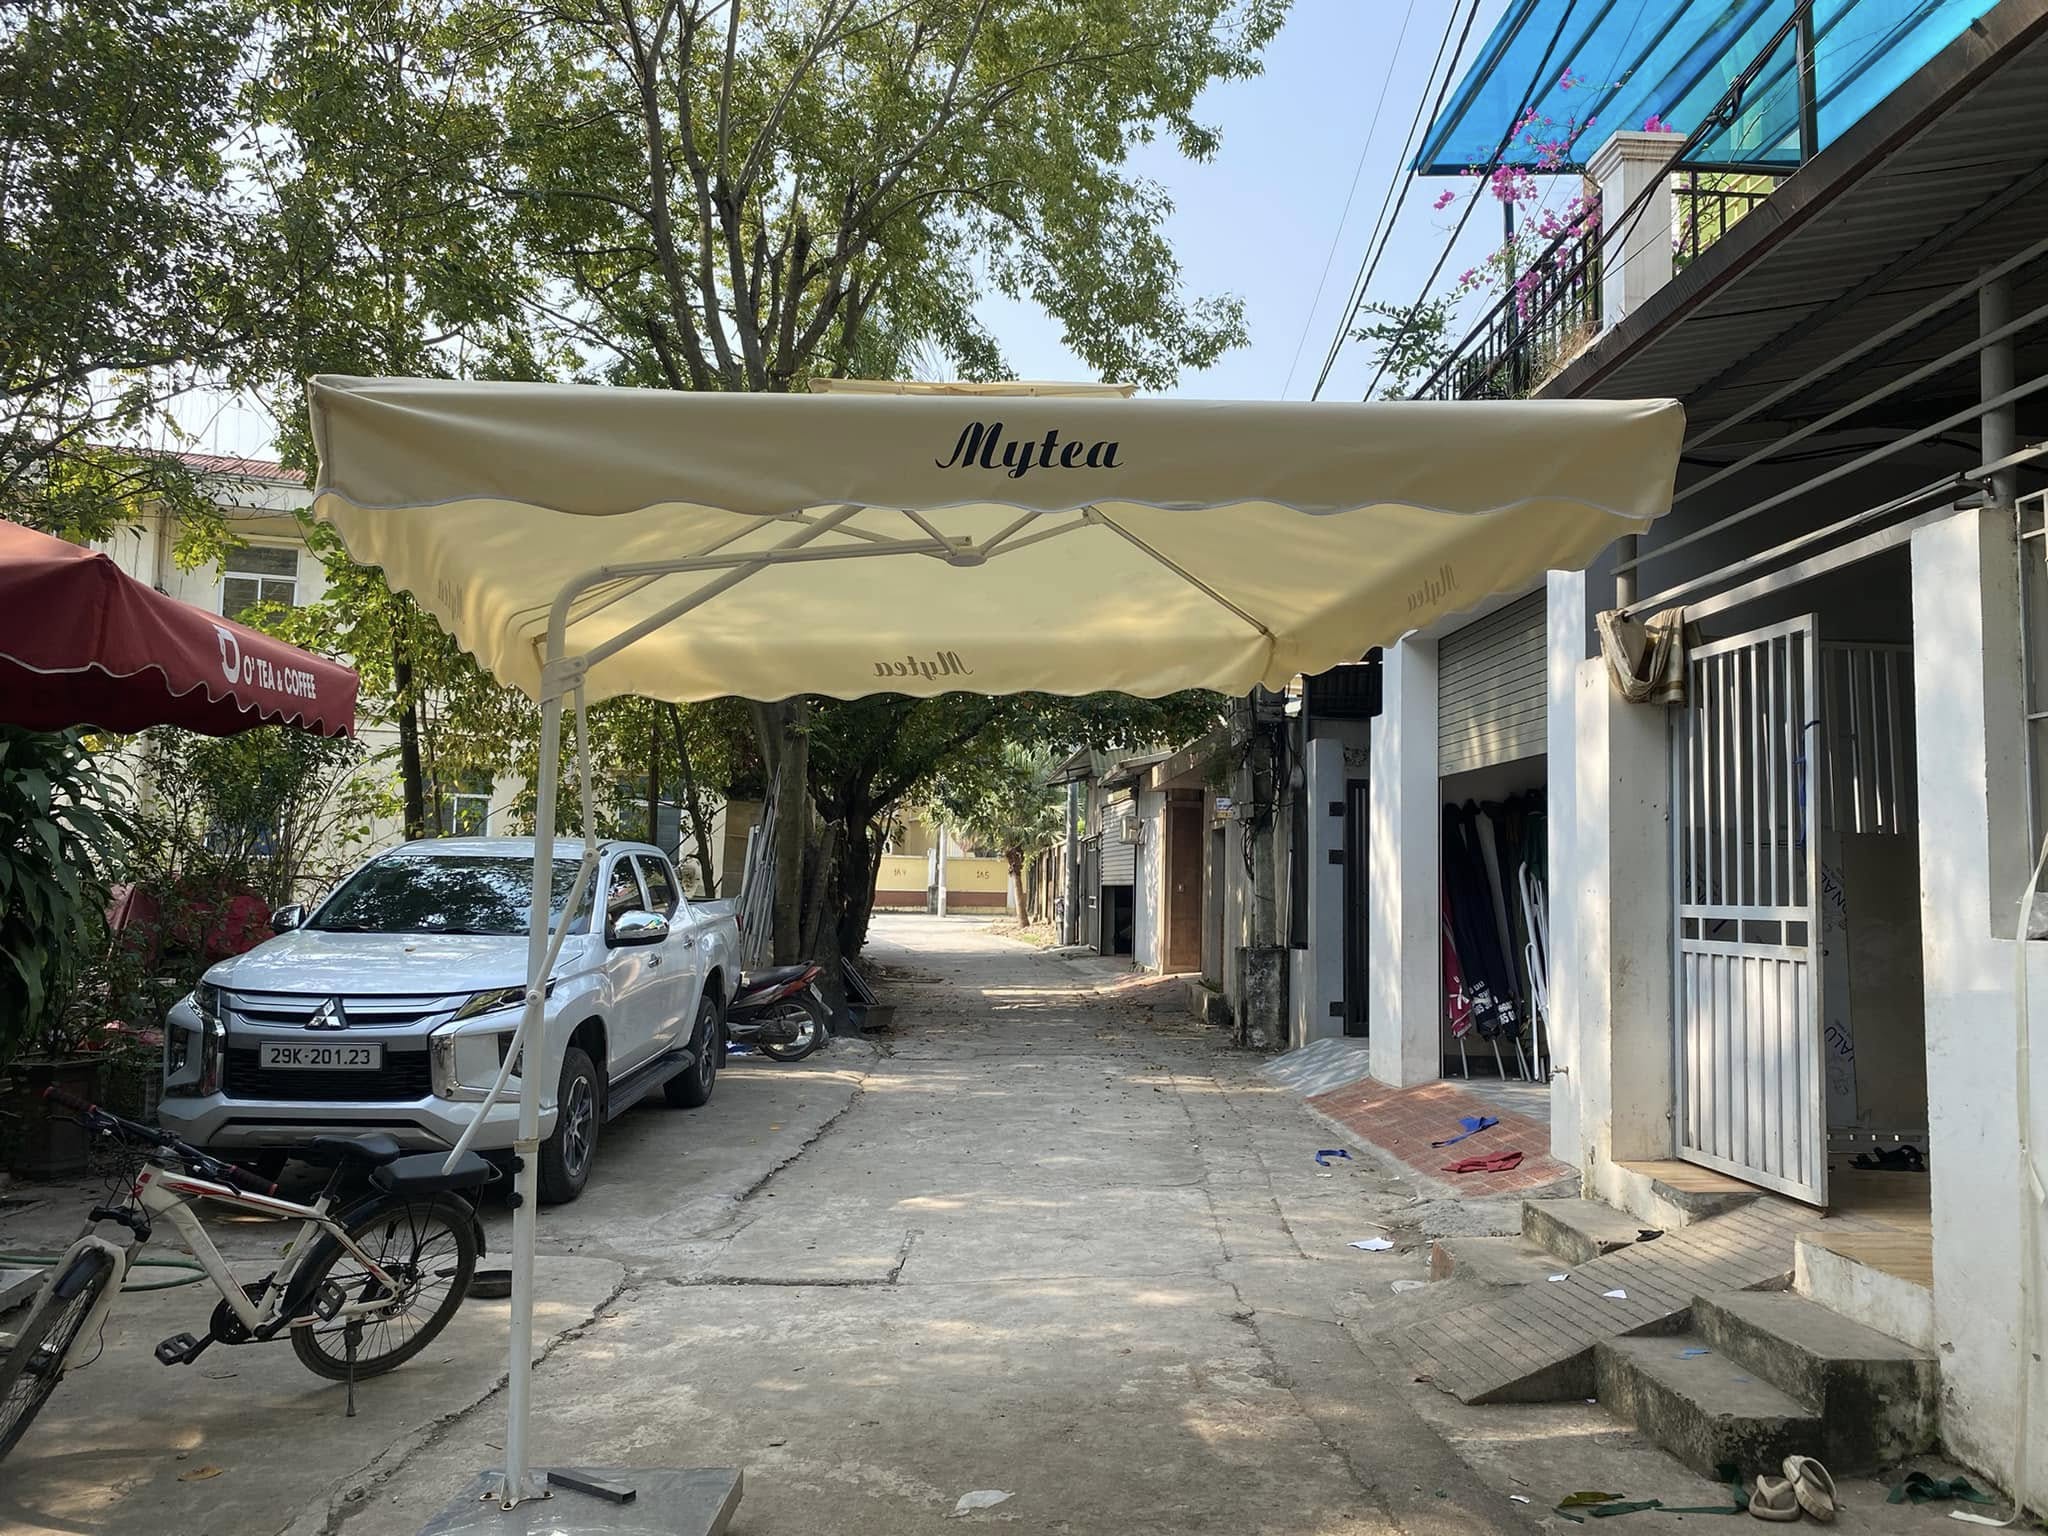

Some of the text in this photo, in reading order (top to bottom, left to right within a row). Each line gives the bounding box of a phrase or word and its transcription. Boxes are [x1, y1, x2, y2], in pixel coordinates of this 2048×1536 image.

[935, 422, 1124, 479] Mytea
[256, 659, 276, 691] TEA
[276, 669, 283, 692] &
[284, 666, 317, 700] COFFEE
